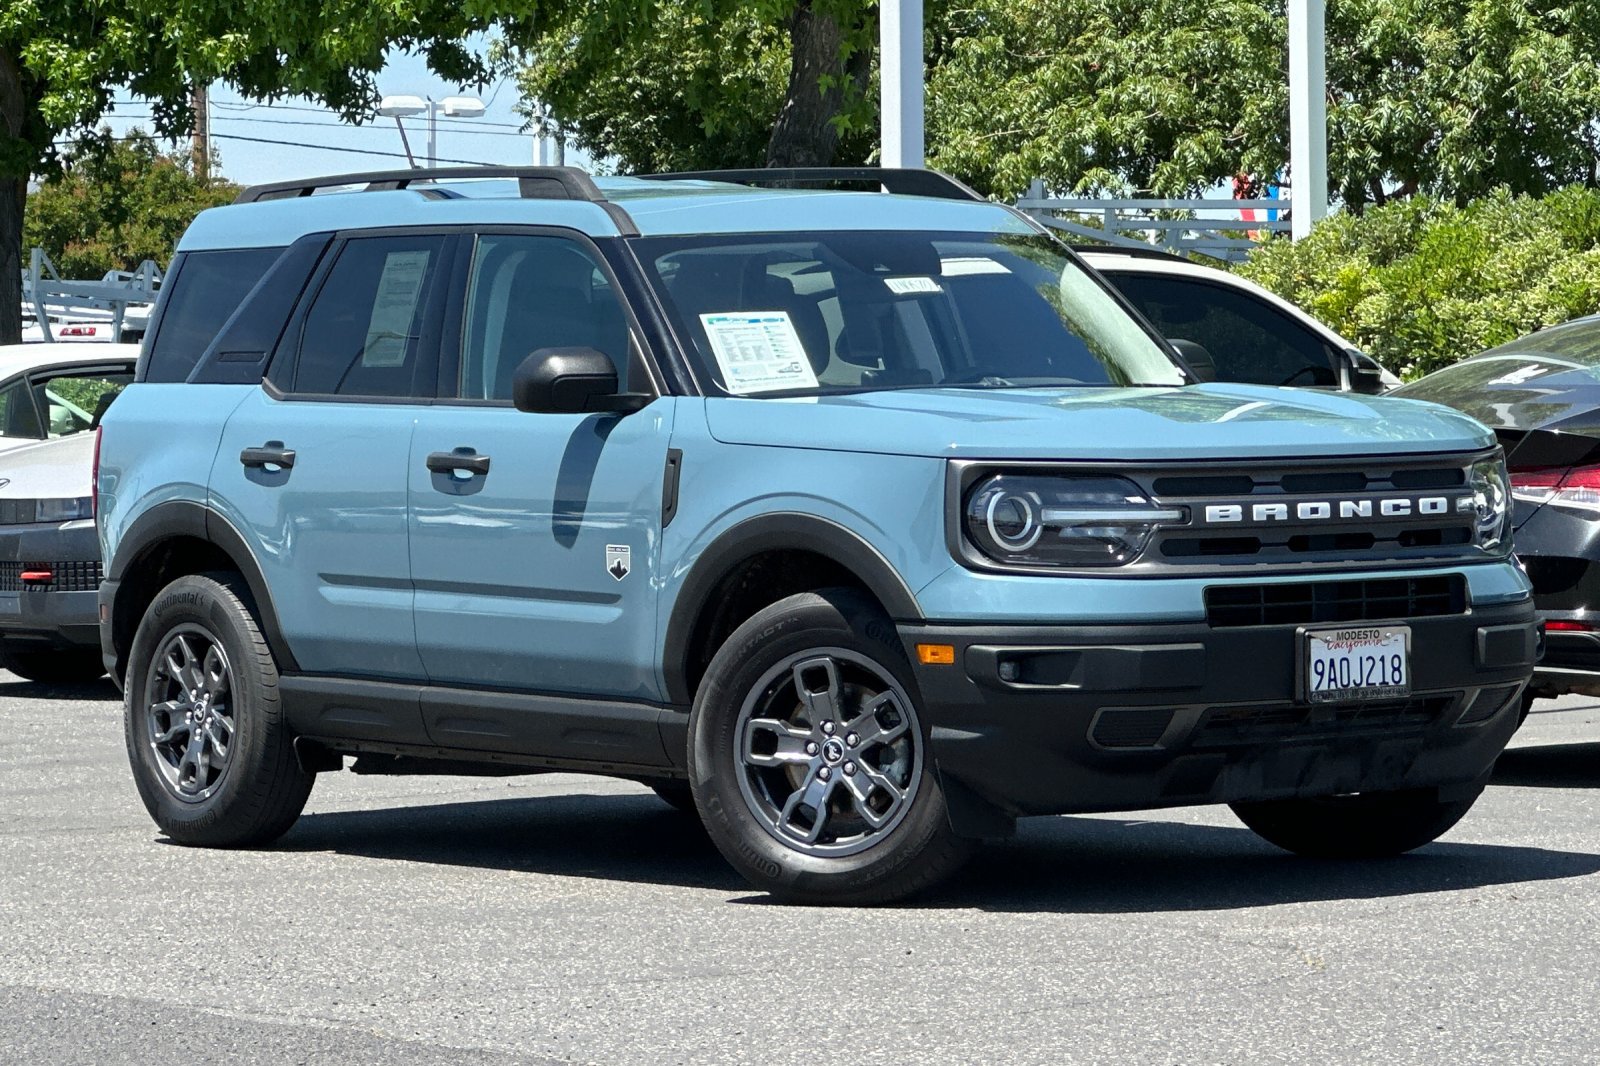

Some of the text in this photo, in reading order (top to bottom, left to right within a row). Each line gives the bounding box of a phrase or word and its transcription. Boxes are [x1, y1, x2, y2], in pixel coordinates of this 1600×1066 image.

[1204, 496, 1449, 523] BRONCO
[154, 591, 199, 616] Continental
[1336, 630, 1380, 641] MODESTO
